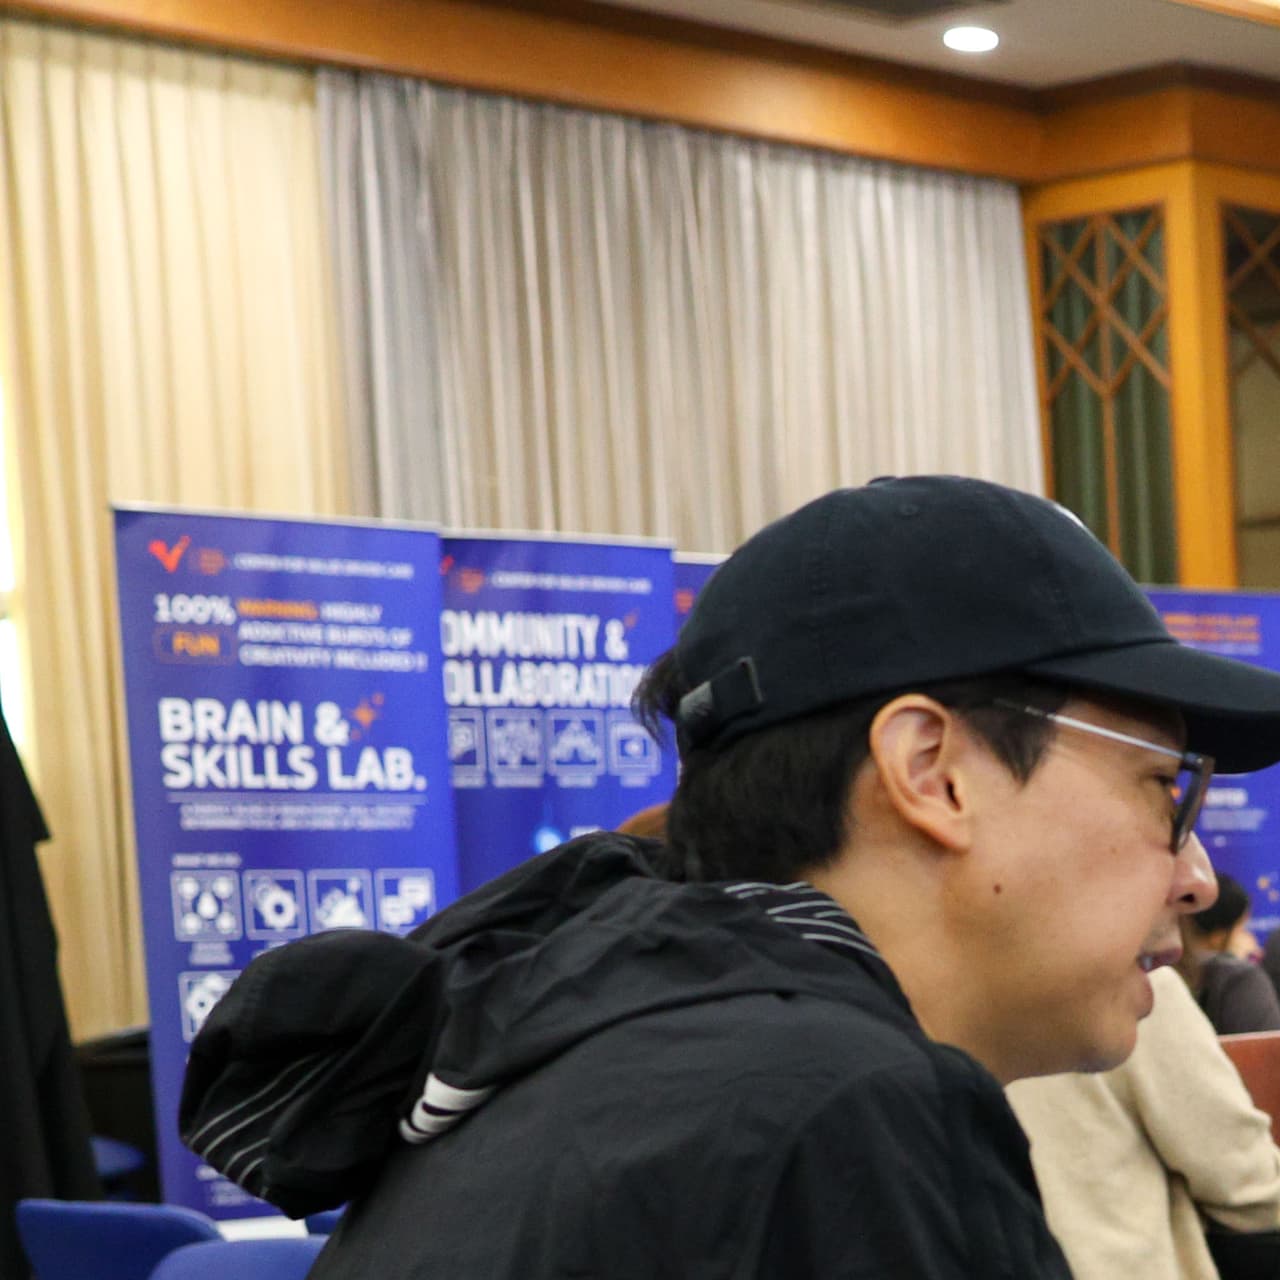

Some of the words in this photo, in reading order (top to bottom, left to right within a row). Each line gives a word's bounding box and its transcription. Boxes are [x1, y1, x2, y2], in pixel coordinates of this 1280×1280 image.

[155, 593, 237, 625] 100%
[440, 610, 600, 661] OMMUNITY
[605, 618, 629, 662] &
[443, 661, 652, 707] OLLABORATIO
[159, 698, 304, 744] BRAIN
[314, 702, 349, 746] &
[161, 743, 318, 789] SKILLS
[327, 746, 427, 791] LAB.
